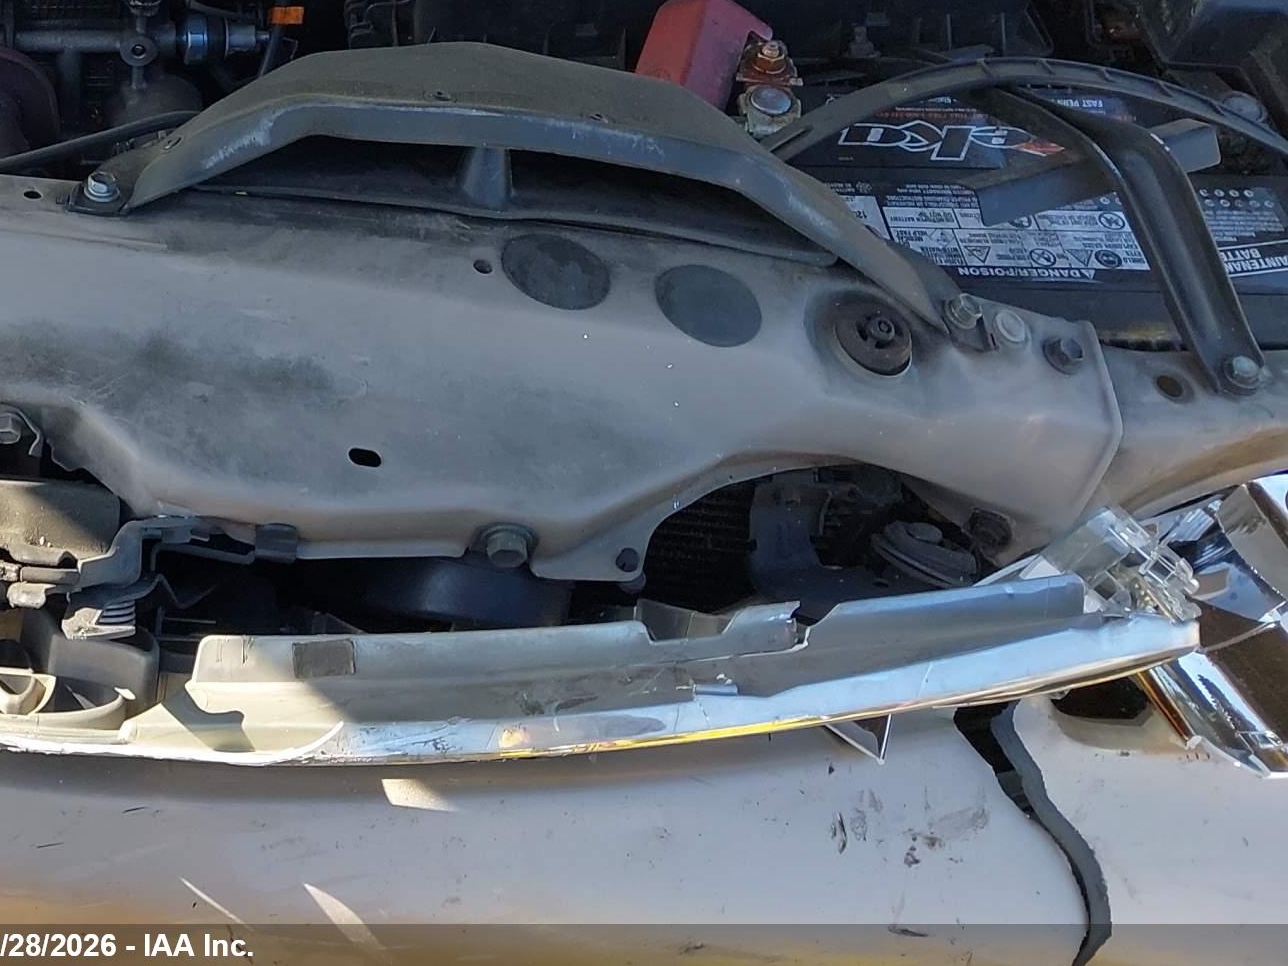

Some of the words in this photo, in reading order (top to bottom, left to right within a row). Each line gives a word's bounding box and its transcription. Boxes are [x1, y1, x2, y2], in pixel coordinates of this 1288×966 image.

[838, 119, 1034, 161] eka
[1219, 247, 1262, 261] BATTE
[958, 266, 1080, 279] DANGER/POISON
[1223, 255, 1288, 274] AINTENAN
